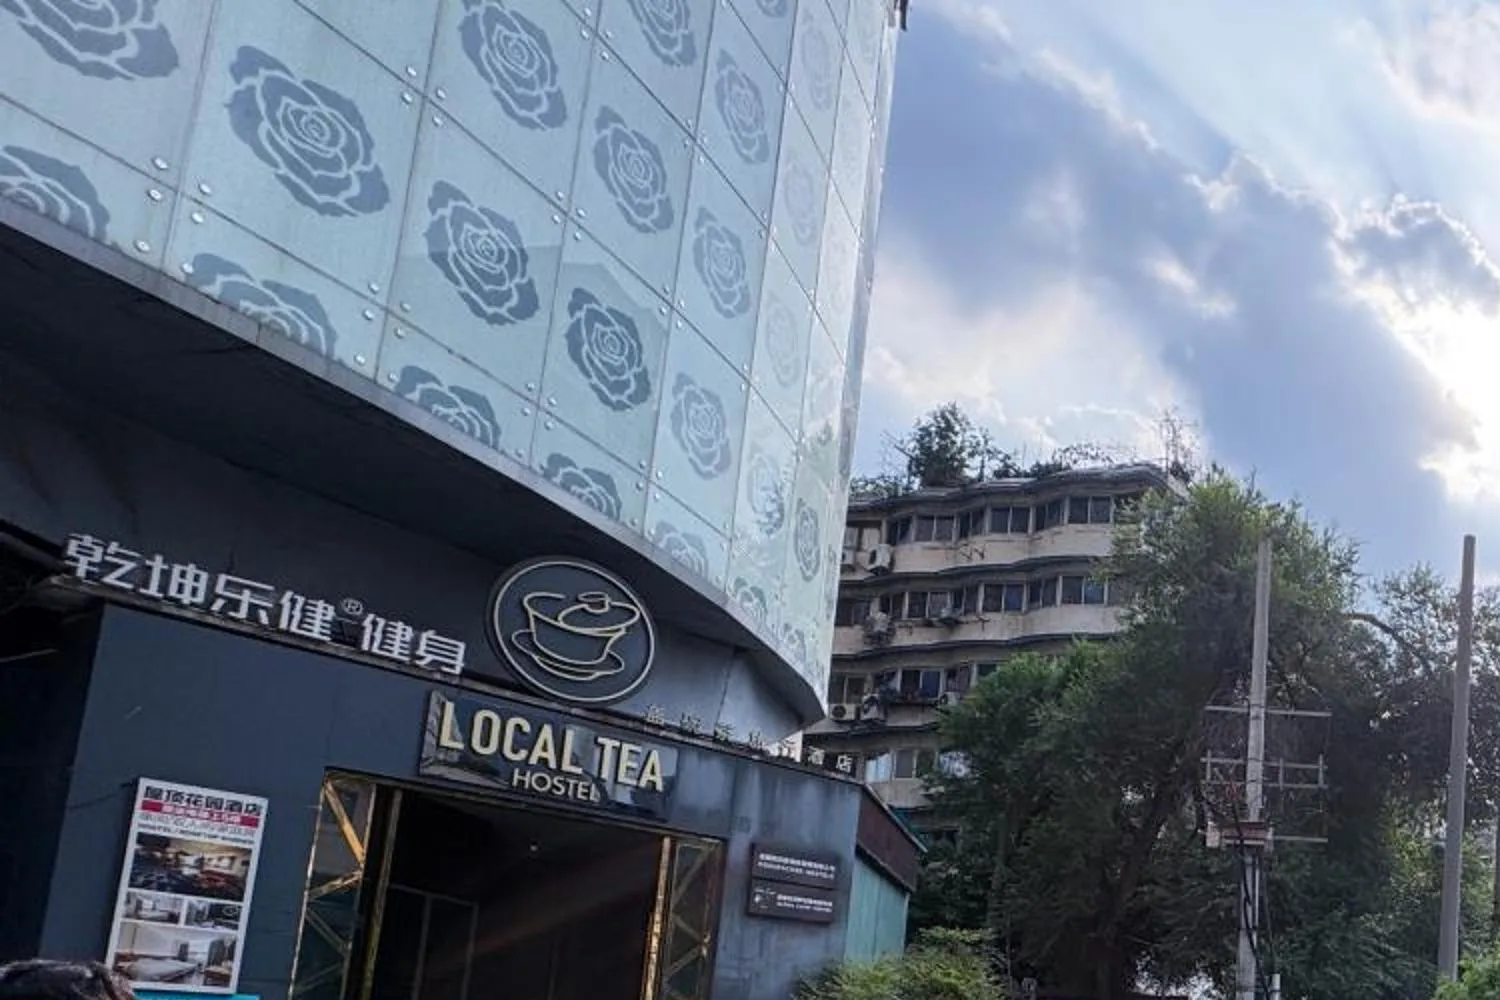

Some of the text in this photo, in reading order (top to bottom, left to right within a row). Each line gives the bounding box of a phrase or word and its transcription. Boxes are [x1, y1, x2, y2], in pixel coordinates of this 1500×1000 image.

[440, 701, 583, 774] LOCAL
[597, 736, 663, 792] TEA
[512, 767, 600, 802] HOSTEL
